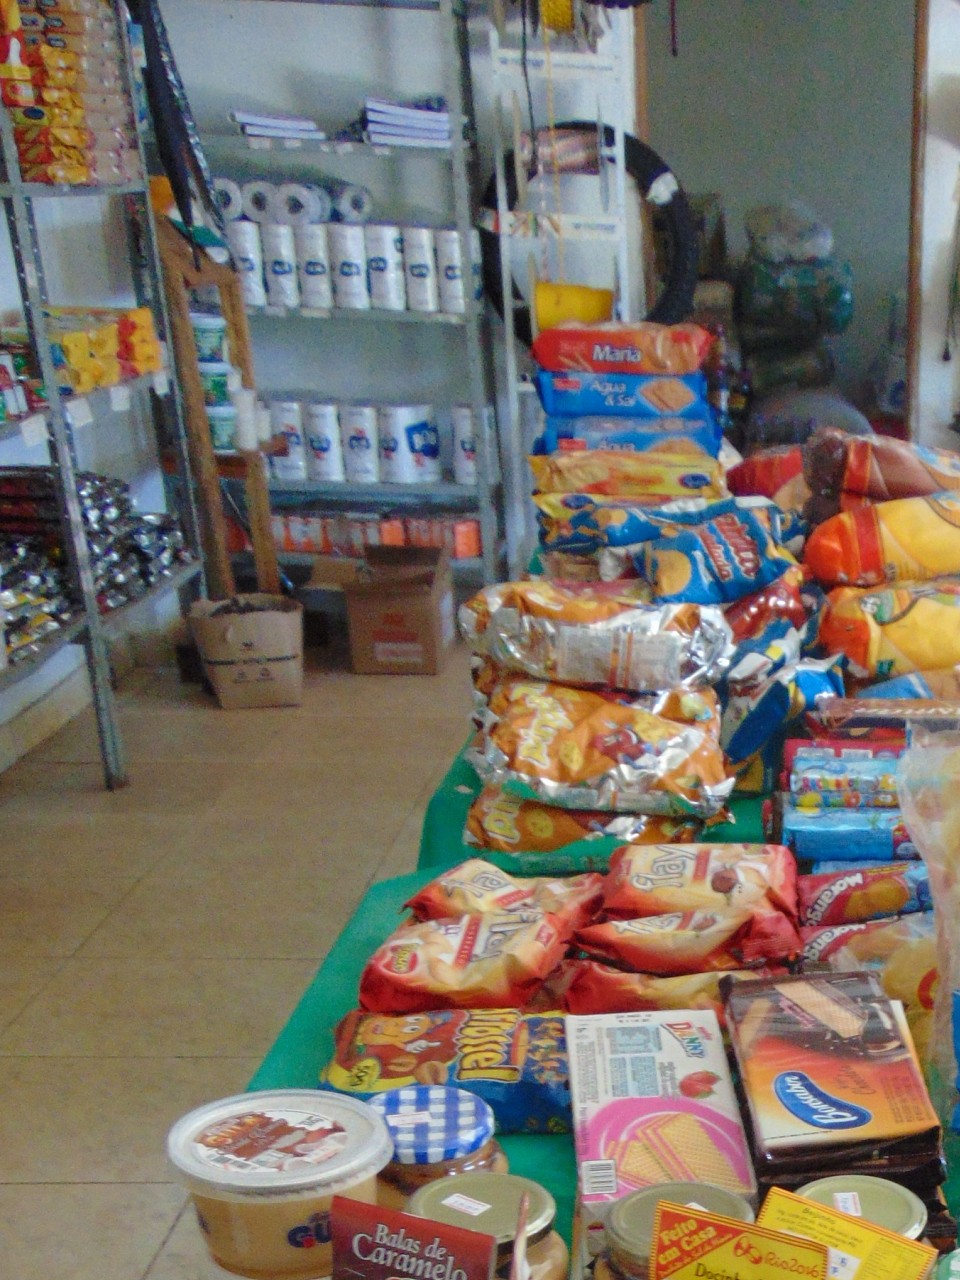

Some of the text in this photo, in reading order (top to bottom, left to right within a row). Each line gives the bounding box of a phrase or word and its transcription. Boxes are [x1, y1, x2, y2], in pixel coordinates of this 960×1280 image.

[592, 344, 642, 363] Maria
[376, 1223, 447, 1260] Balas de
[658, 1226, 717, 1264] em Casa
[660, 1219, 698, 1245] Feito
